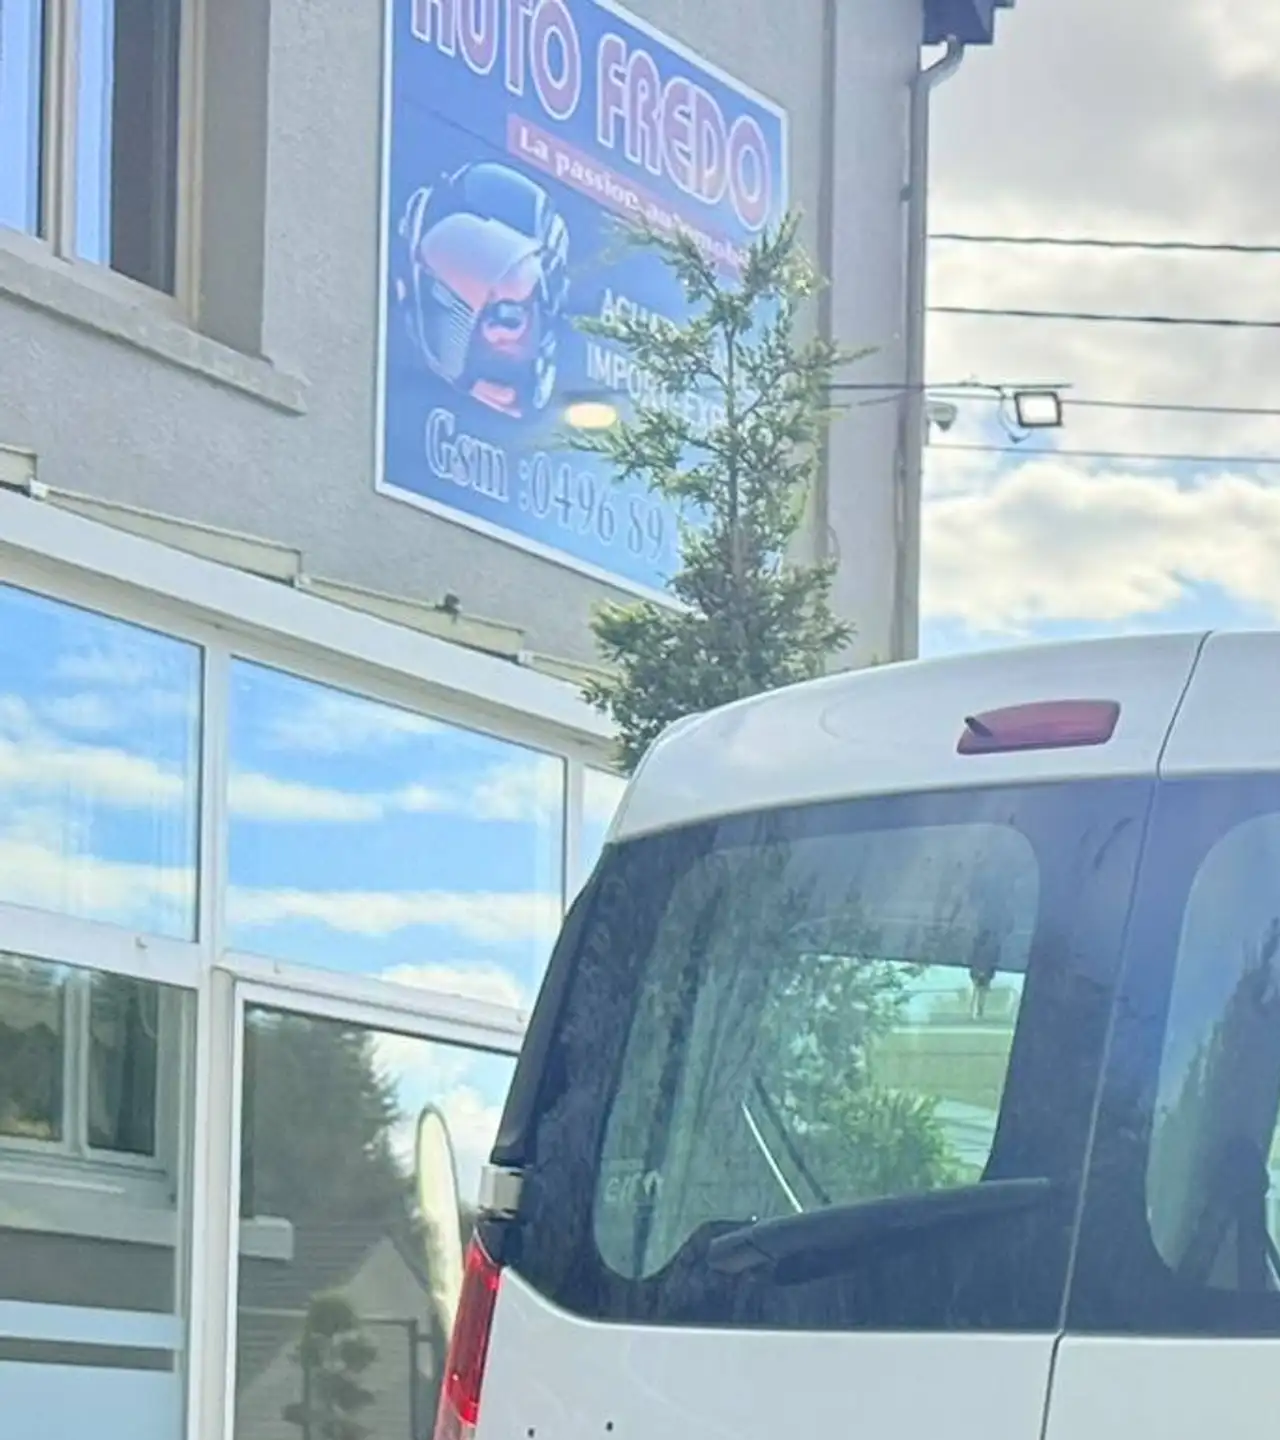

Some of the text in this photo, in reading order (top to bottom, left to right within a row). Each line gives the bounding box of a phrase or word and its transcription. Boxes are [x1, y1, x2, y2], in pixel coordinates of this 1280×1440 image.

[519, 125, 550, 163] La
[597, 33, 772, 233] FREDO
[424, 406, 510, 504] Gsm
